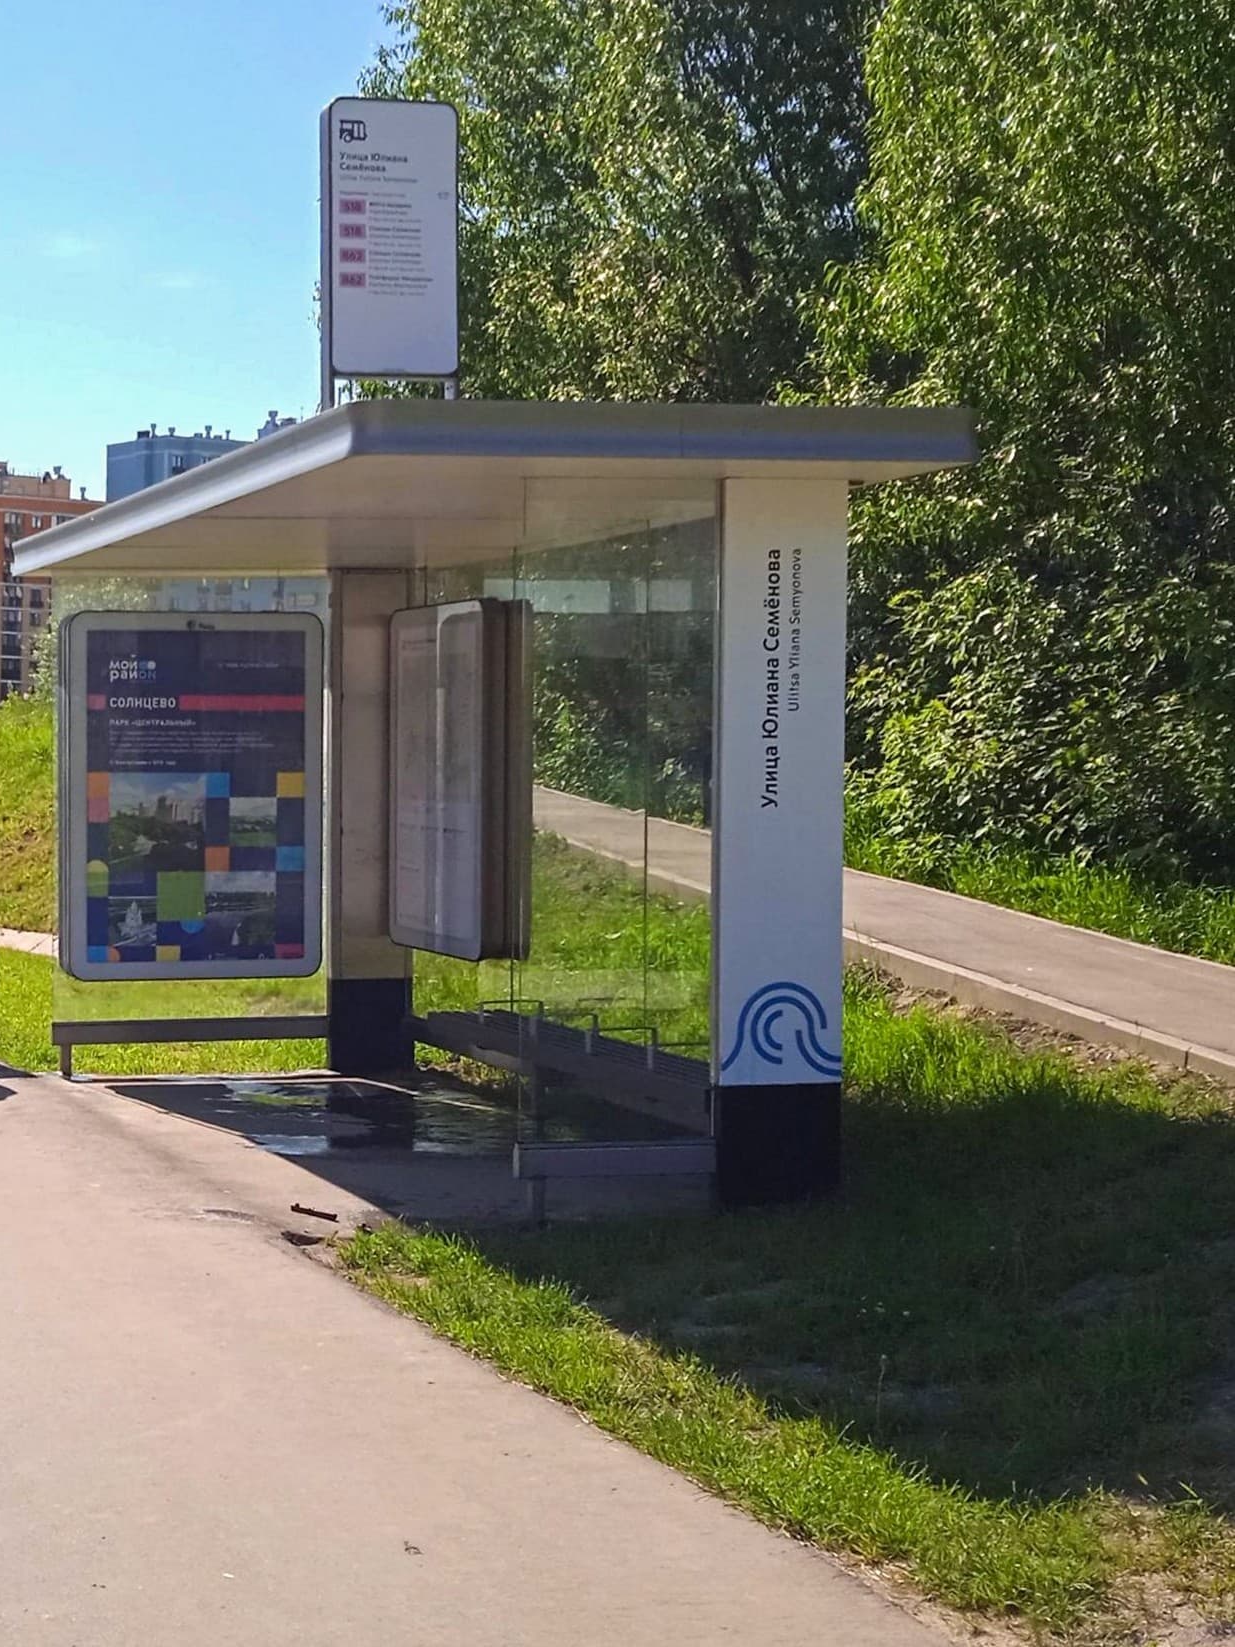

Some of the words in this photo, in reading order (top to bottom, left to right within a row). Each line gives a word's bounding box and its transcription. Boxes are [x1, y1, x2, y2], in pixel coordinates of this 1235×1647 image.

[762, 548, 781, 653] Семёнова
[789, 548, 803, 625] Semyonova
[109, 697, 176, 709] СОЛНЦЕВО
[762, 656, 780, 739] Юлиана
[788, 672, 800, 712] Ulitsa
[760, 746, 780, 808] Улица
